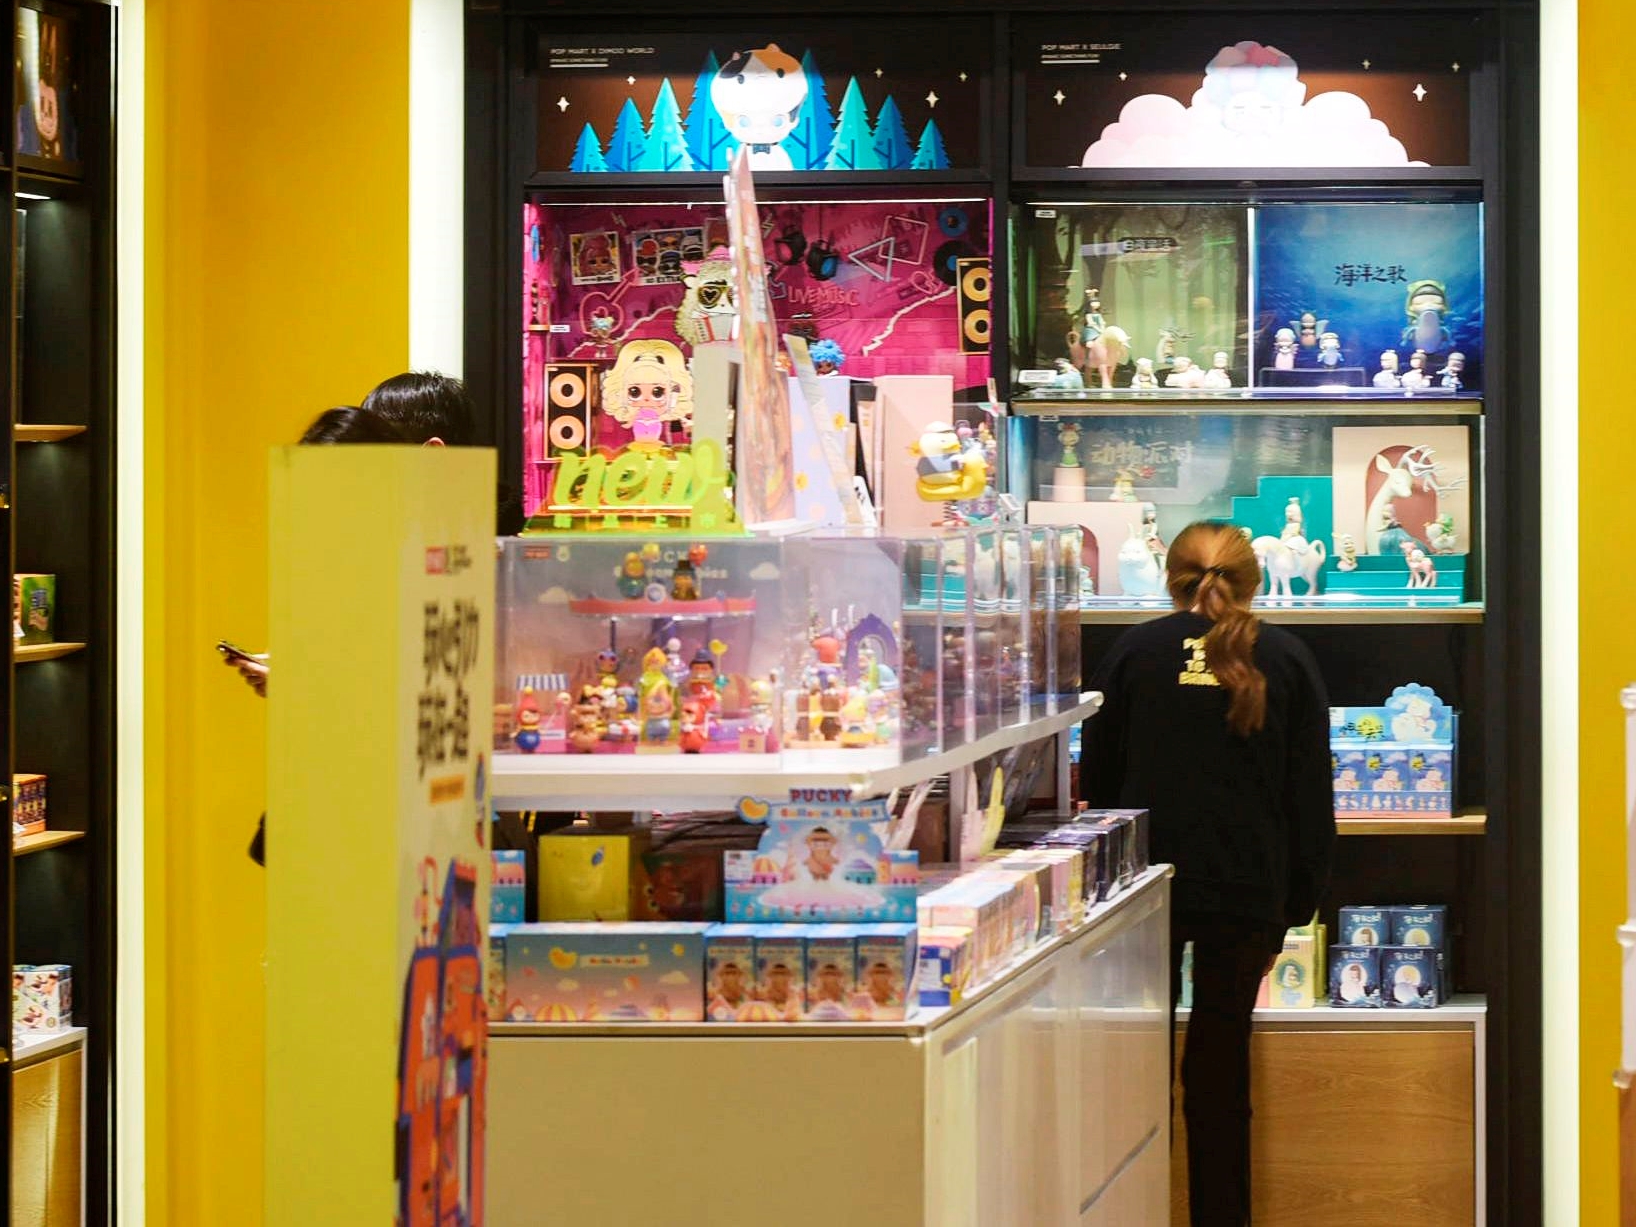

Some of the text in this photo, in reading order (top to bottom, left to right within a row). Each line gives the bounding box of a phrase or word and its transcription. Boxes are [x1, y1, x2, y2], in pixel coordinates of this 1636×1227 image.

[1333, 262, 1408, 287] 海洋之歌
[788, 285, 816, 304] LIVE
[553, 437, 728, 507] new
[789, 788, 853, 803] PUCKY
